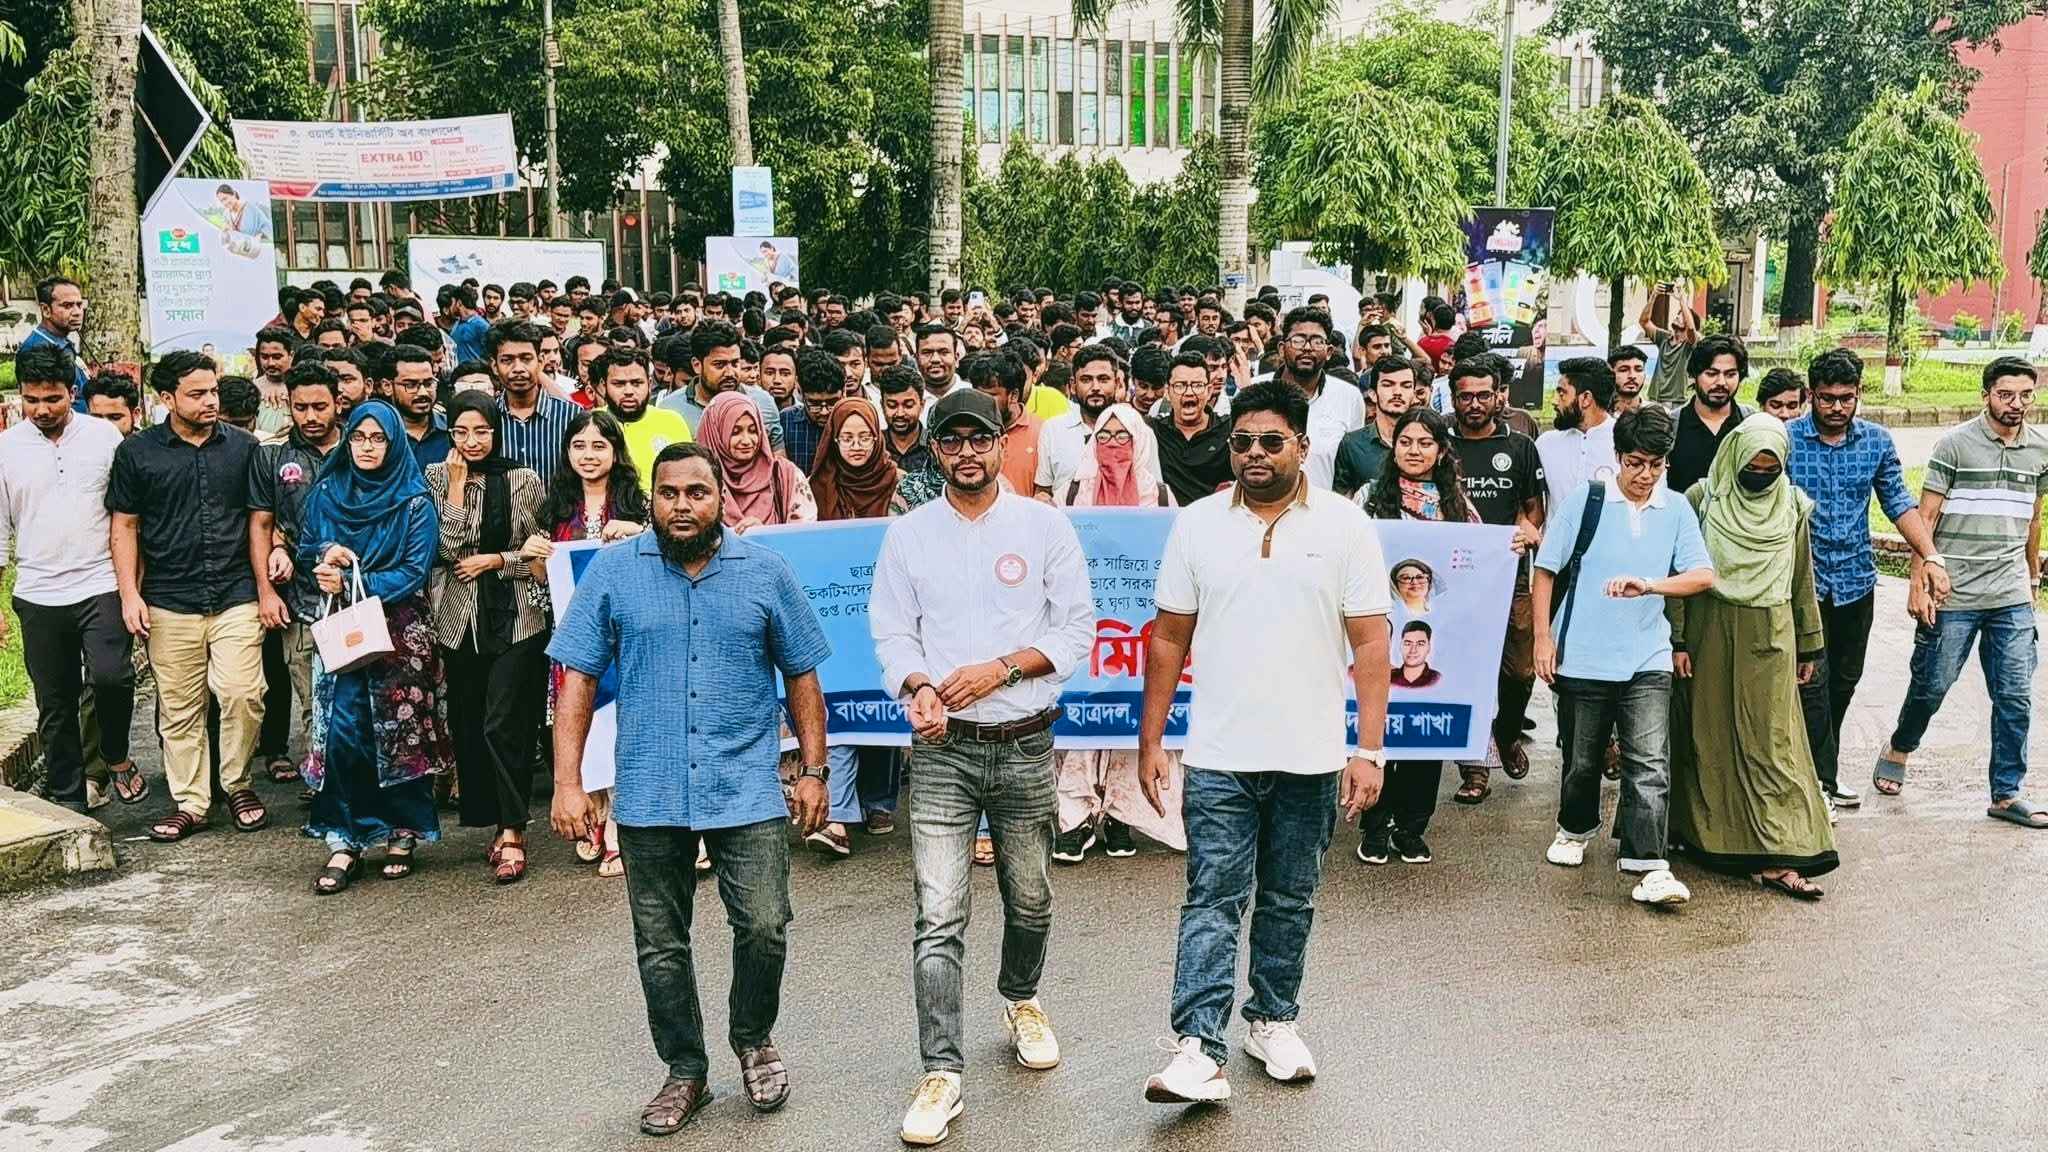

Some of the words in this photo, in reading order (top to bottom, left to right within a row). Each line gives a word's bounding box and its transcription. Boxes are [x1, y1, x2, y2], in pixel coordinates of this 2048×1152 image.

[416, 126, 461, 137] বাংলাদেশ
[360, 152, 404, 163] EXTRA
[165, 310, 204, 321] সম্মান
[1103, 554, 1149, 572] সাজিয়ে
[1120, 577, 1157, 591] সরকা
[1108, 597, 1131, 613] ঘৃণ্য
[832, 699, 909, 723] বাংলাদে
[1063, 700, 1138, 729] ছাত্রদল,
[1409, 711, 1454, 736] শাখা
